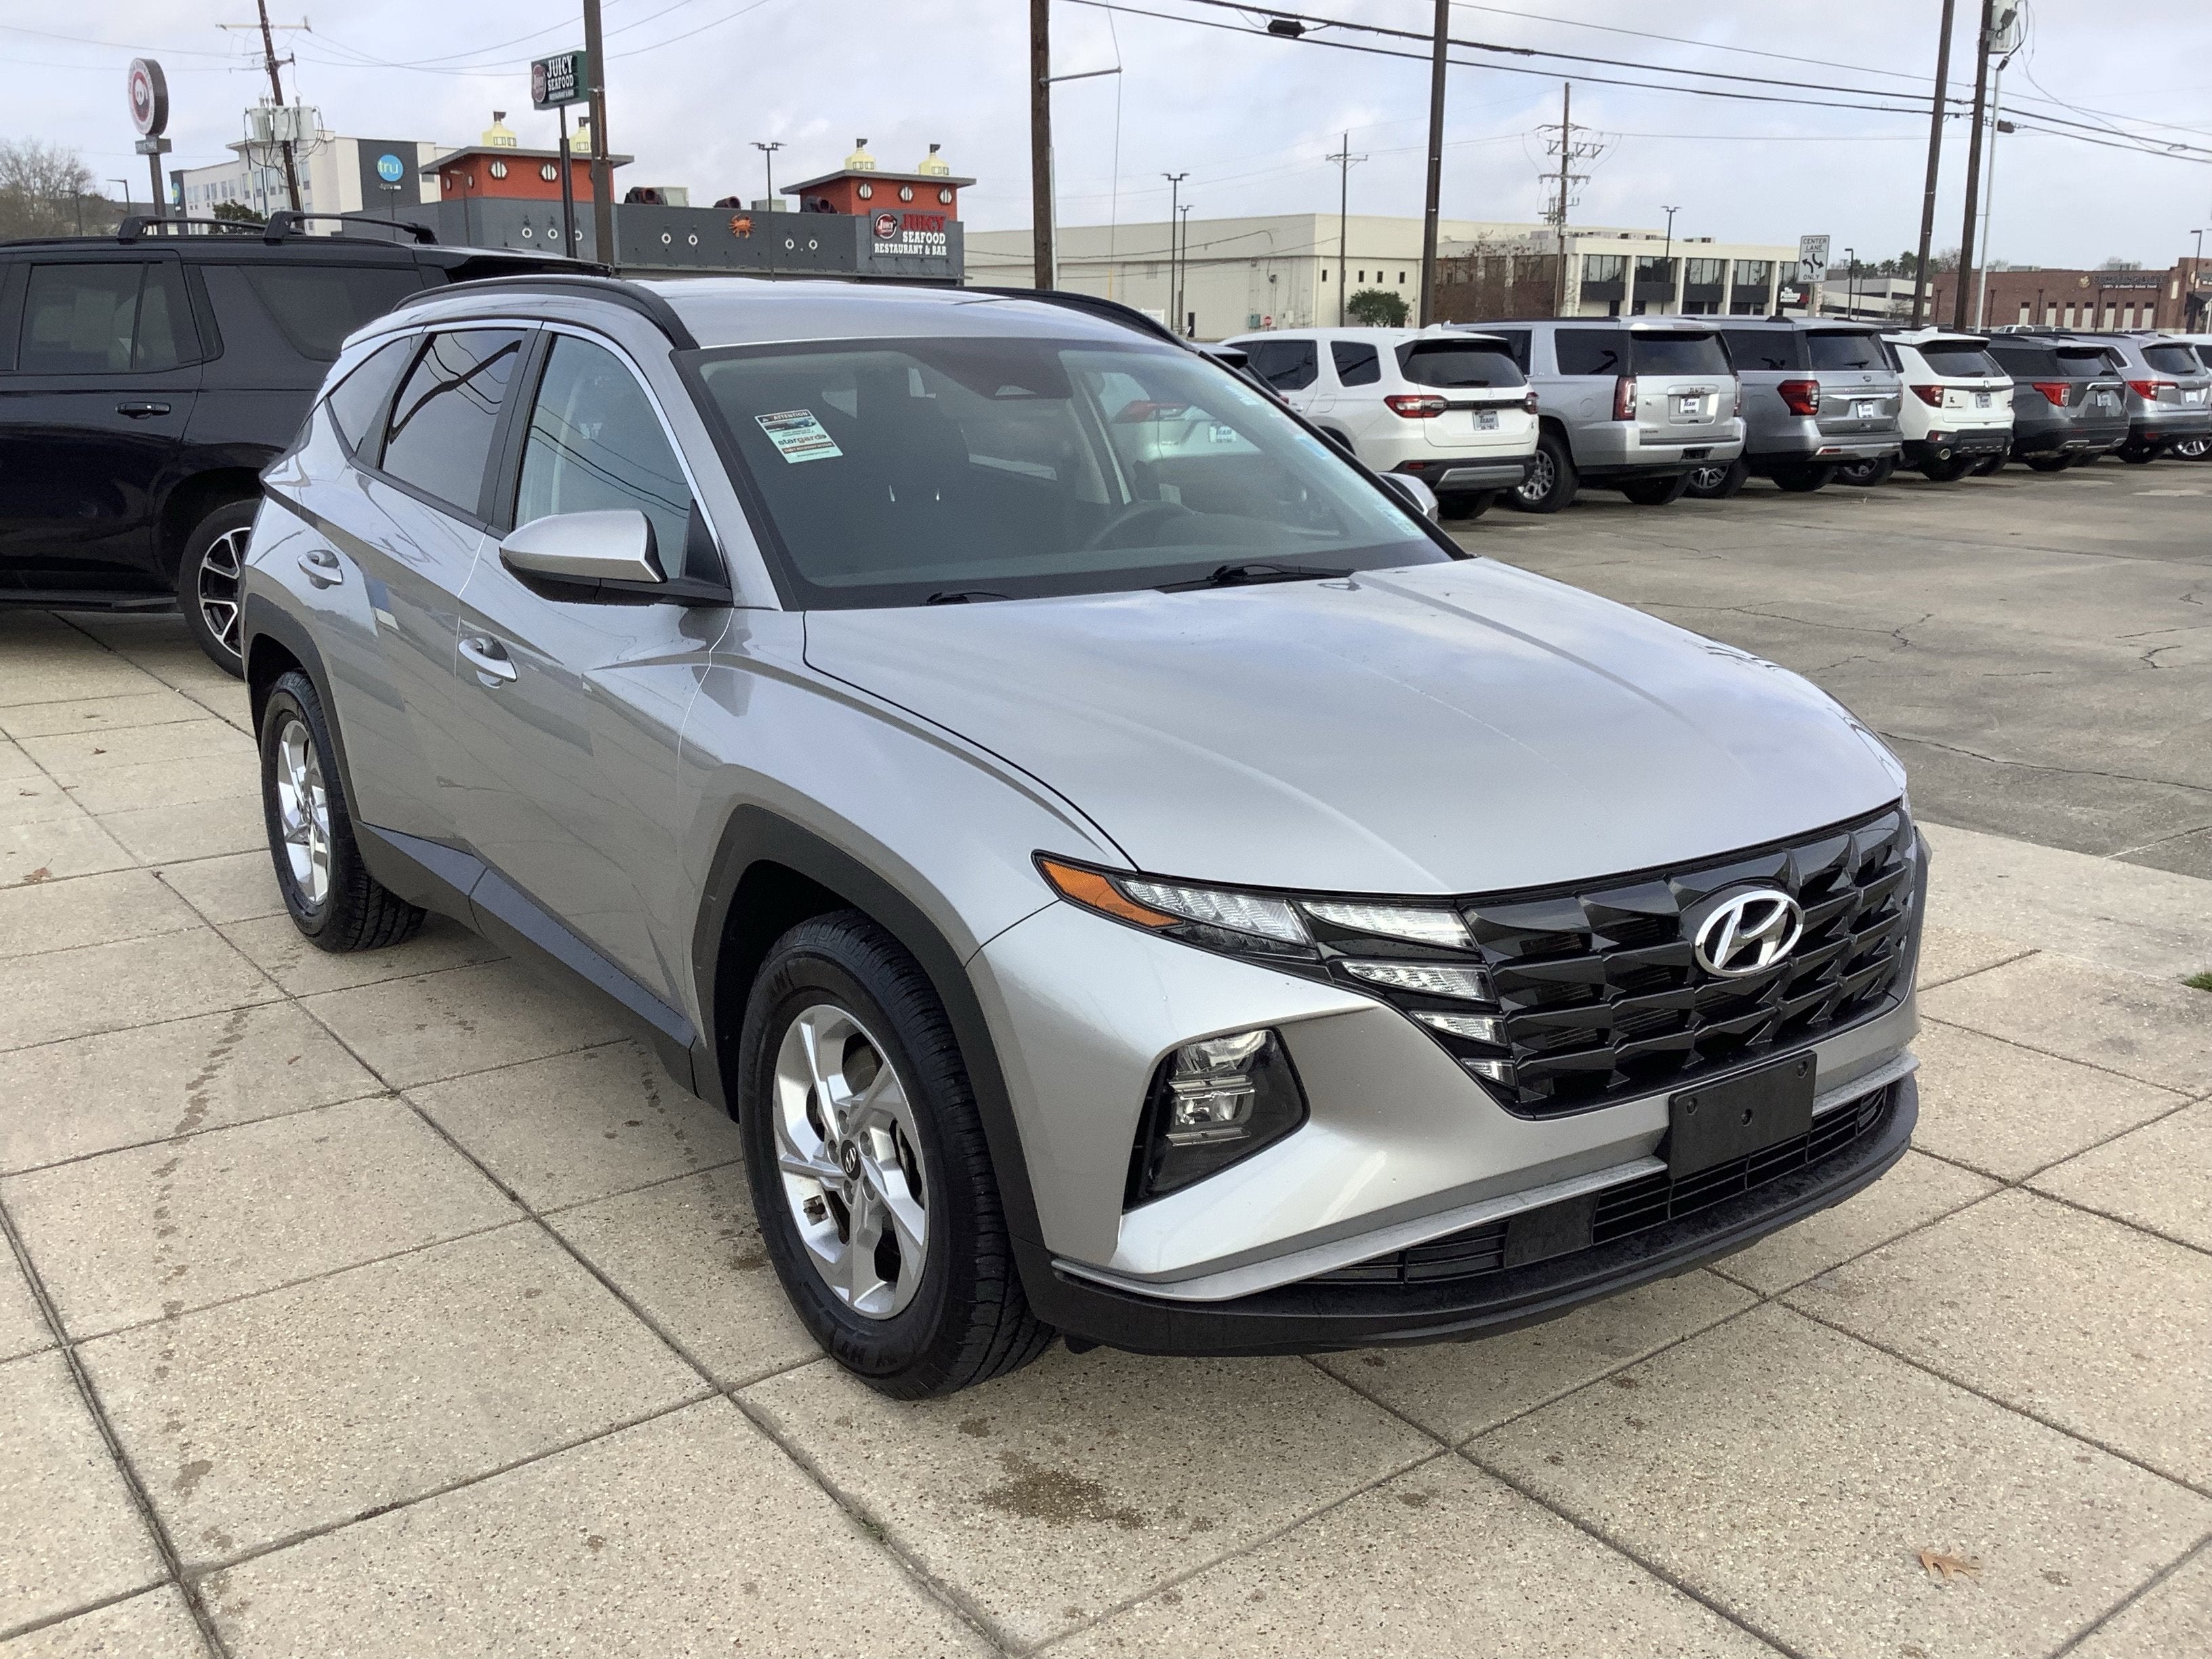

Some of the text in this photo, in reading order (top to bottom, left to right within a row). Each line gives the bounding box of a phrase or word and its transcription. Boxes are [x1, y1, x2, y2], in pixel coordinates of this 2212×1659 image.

[547, 55, 573, 79] JUICY
[548, 75, 574, 91] SEAFOOD
[378, 160, 398, 174] tru
[900, 214, 945, 231] JUICY
[903, 231, 946, 244] SEAFOOD
[874, 243, 947, 255] RESTAURANT & BAR
[773, 411, 808, 421] ATTENTION
